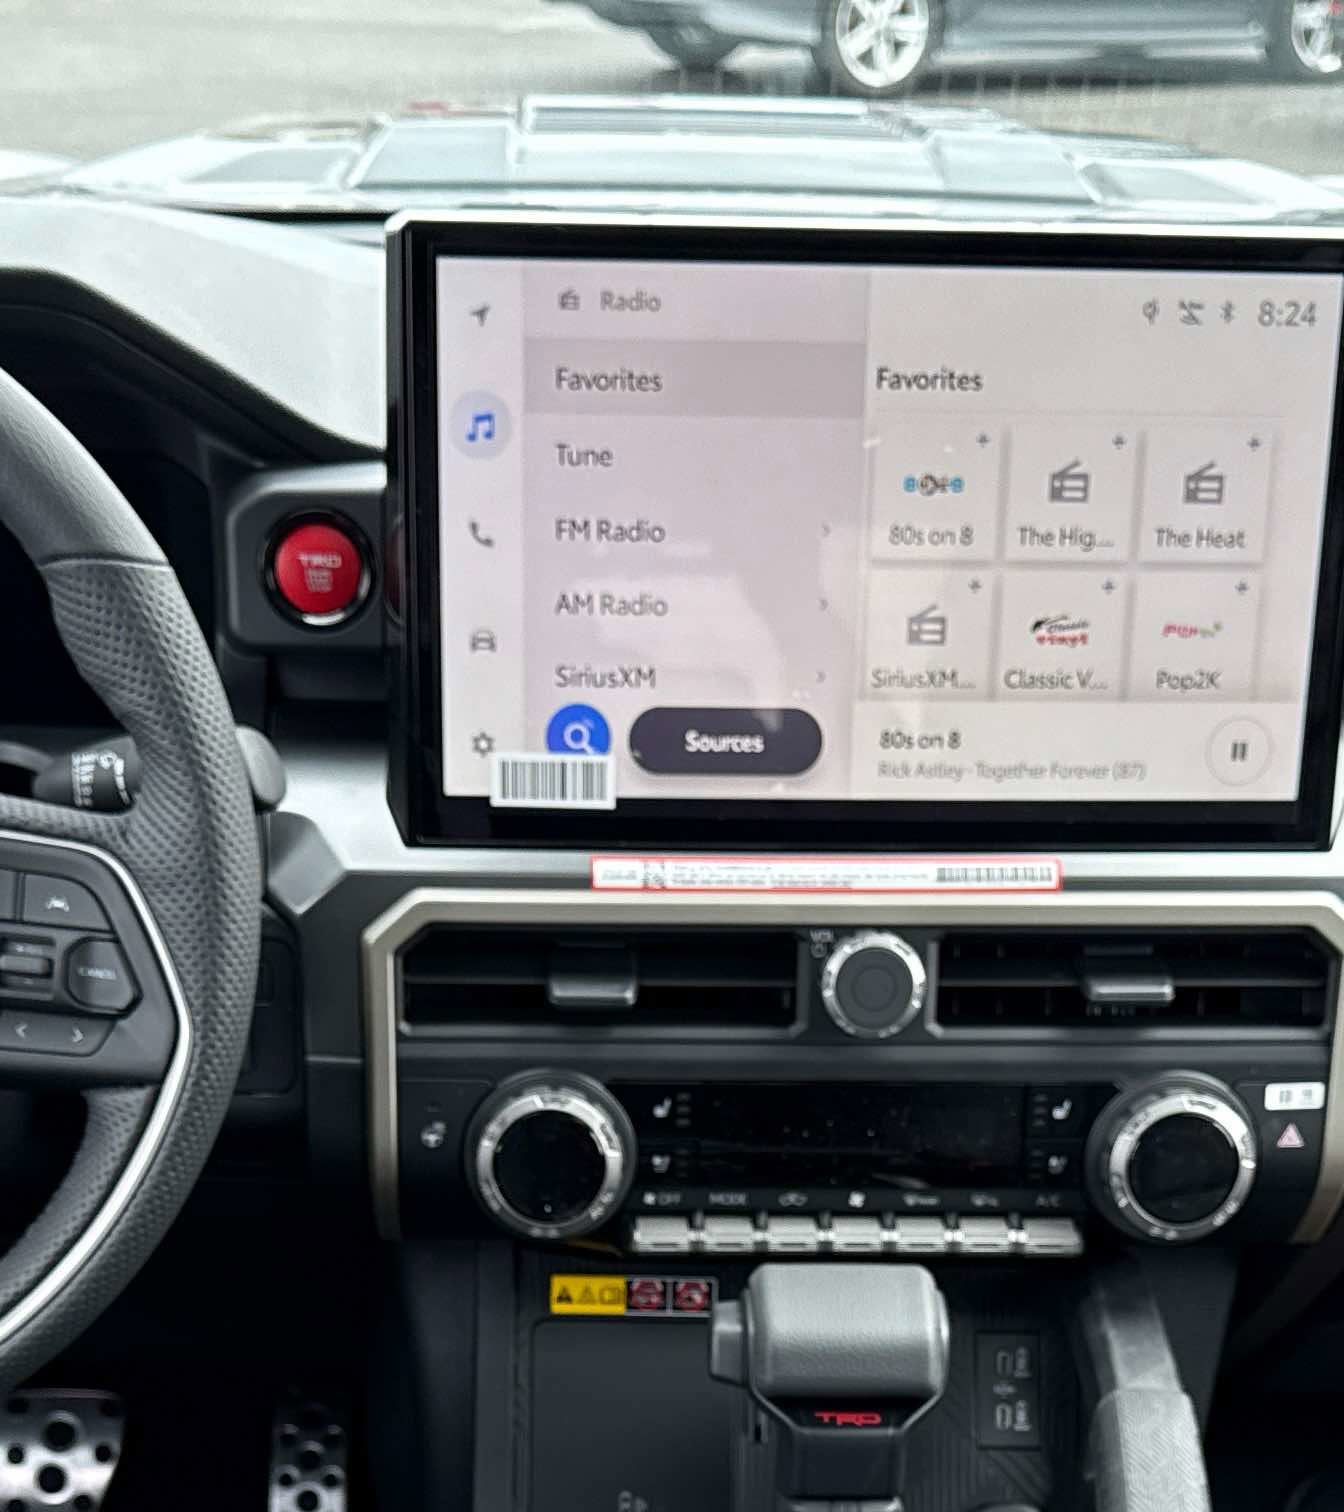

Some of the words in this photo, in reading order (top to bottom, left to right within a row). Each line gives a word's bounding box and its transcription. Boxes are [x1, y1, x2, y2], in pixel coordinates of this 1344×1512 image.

[600, 290, 662, 312] Radio
[1257, 301, 1317, 327] 8:24
[555, 367, 663, 392] Favorites
[875, 367, 984, 392] Favorites
[555, 443, 614, 467] Tune
[555, 518, 591, 543] FM
[596, 518, 666, 544] Radio
[888, 523, 925, 547] 80s
[928, 529, 957, 547] on
[959, 523, 975, 547] 8
[1018, 526, 1055, 548] The
[1155, 527, 1192, 549] The
[1195, 527, 1247, 549] Heat
[555, 594, 594, 617] AM
[600, 593, 669, 618] Radio
[555, 666, 657, 689] SiriusXM
[1004, 668, 1073, 690] Classic
[1156, 669, 1222, 692] Pop2K
[684, 730, 765, 754] Sources
[879, 728, 915, 750] 80s
[917, 735, 944, 750] on
[947, 729, 962, 750] 8
[814, 1411, 882, 1427] TRD
